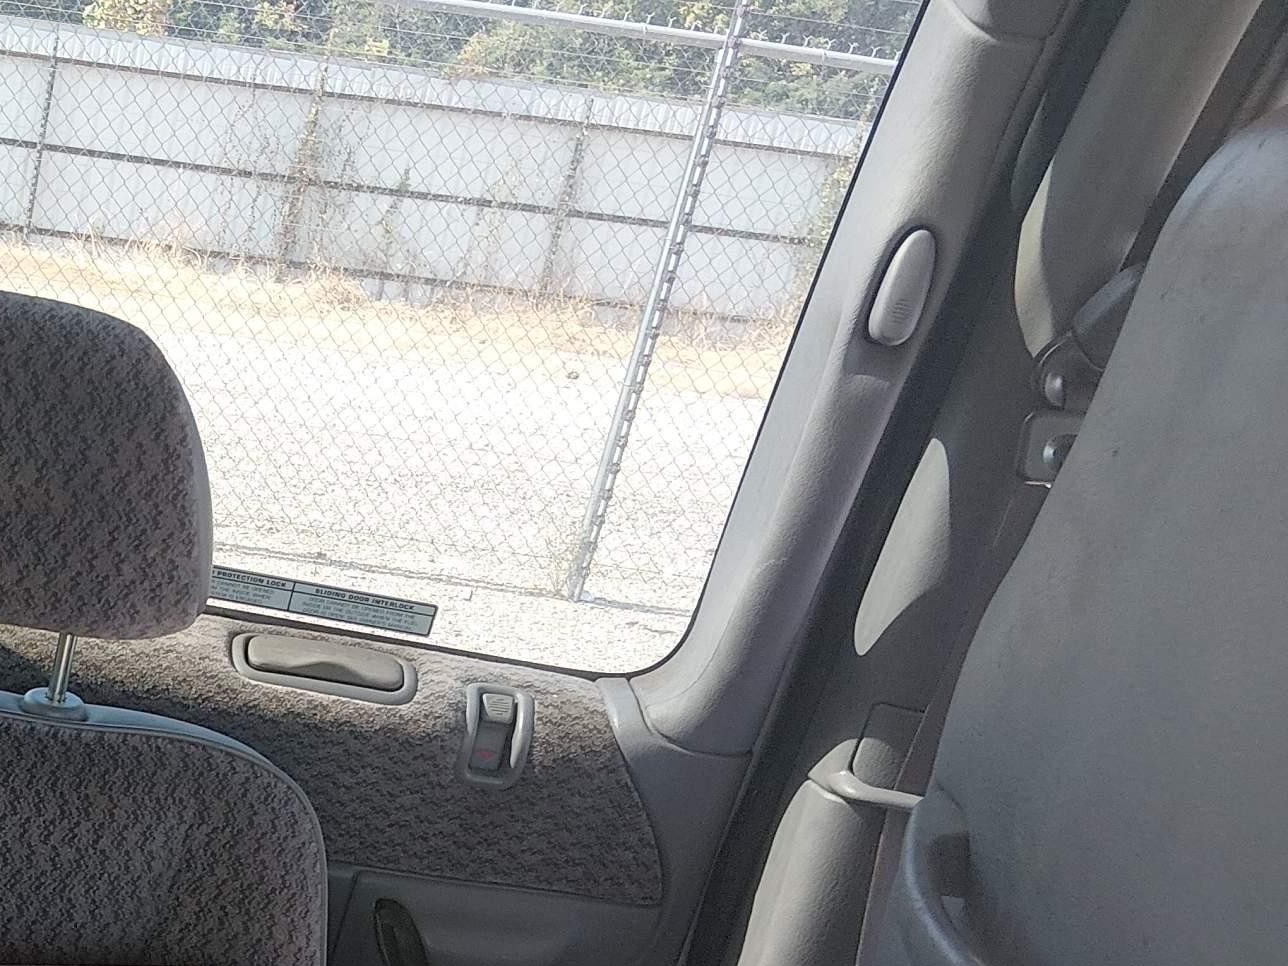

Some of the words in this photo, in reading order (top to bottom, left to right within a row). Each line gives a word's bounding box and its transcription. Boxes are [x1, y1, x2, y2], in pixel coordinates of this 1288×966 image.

[216, 571, 265, 584] PROTECTION
[266, 579, 287, 587] LOCK
[315, 588, 346, 599] SLIDING
[348, 594, 370, 603] DOOR
[371, 598, 416, 611] INTERLOCK
